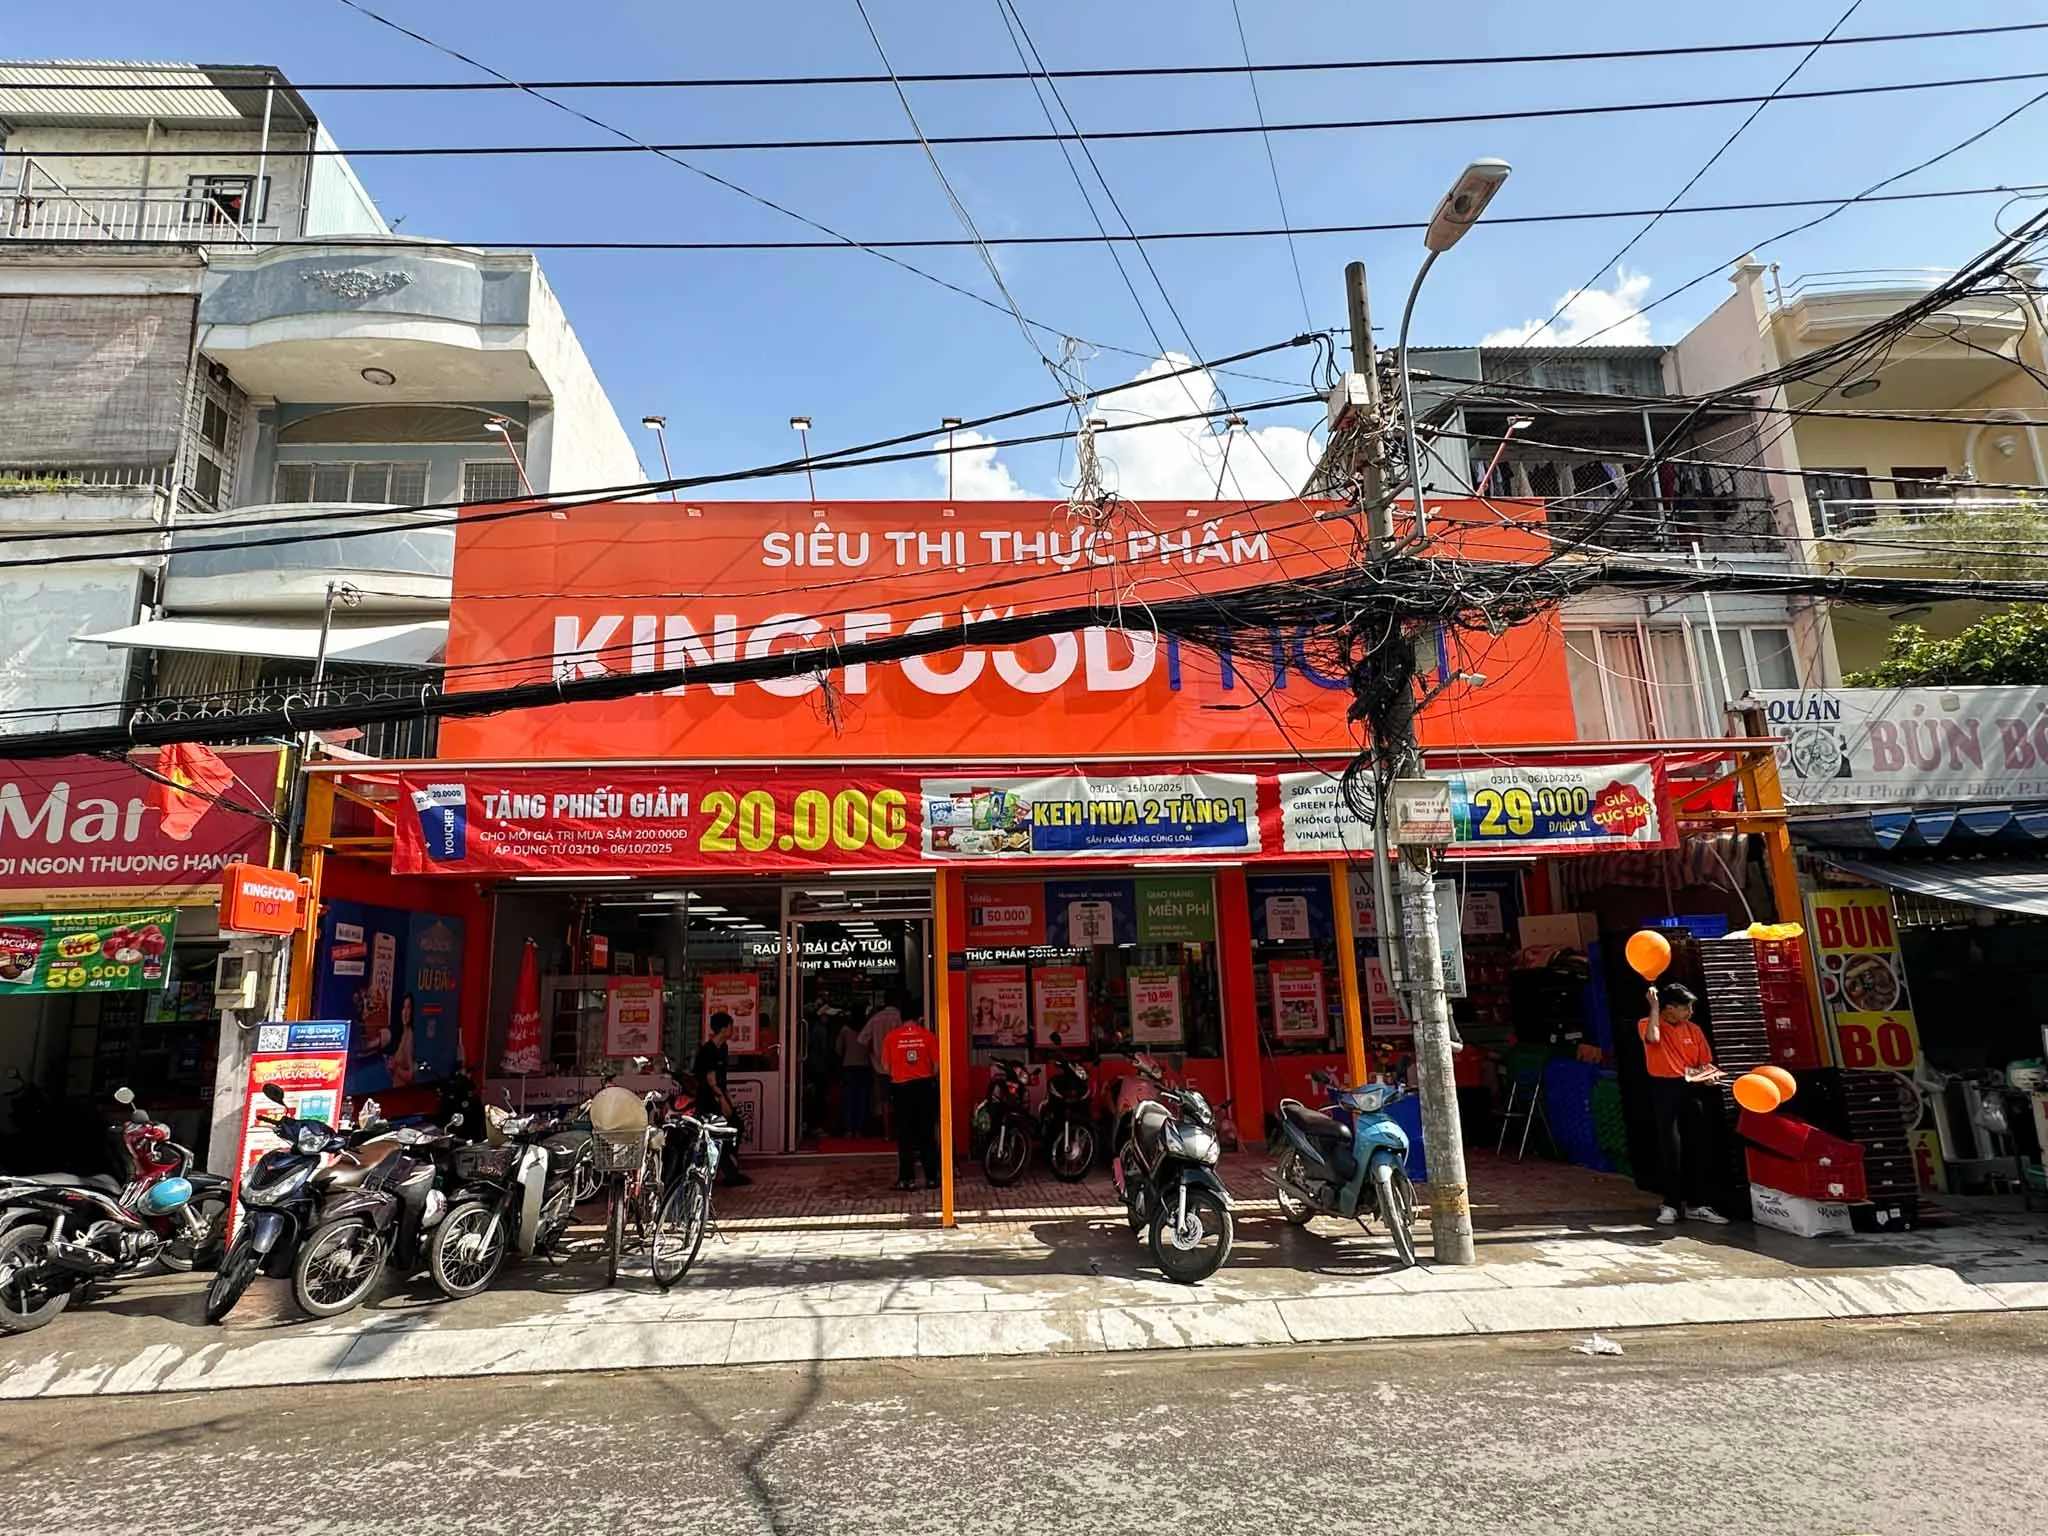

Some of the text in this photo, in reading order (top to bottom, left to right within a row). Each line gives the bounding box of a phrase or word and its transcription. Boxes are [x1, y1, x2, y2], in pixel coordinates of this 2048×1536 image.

[762, 522, 869, 567] SIÊU
[884, 531, 966, 573] THỊ
[979, 525, 1116, 573] THỰC
[552, 603, 1156, 697] KINGFOOD
[1768, 695, 1840, 721] QUÁN
[1090, 785, 1117, 794] 03/10
[1127, 783, 1182, 793] 15/10/2025
[1491, 776, 1518, 785] 03/10
[1528, 775, 1583, 784] 06/10/2025
[2018, 782, 2048, 796] P.1
[1292, 786, 1311, 796] SỮA
[1604, 792, 1631, 807] GIÁ
[0, 782, 192, 844] Mar
[482, 785, 689, 827] TẶNG PHIẾU GIẢM
[1033, 794, 1246, 830] KEM MUA 2 TẶNG 1
[1293, 801, 1352, 810] GREEN FAR
[1474, 786, 1589, 836] 29.000
[1295, 814, 1370, 824] KHÔNG ĐƯỜ
[444, 809, 455, 854] VOUCHER
[480, 831, 505, 840] CHO
[533, 828, 554, 840] GIÁ
[557, 831, 574, 842] TRỊ
[577, 830, 603, 840] MUA
[1296, 831, 1344, 839] VINAMILK
[494, 843, 510, 855] ÁP
[513, 845, 547, 857] DỤNG
[569, 844, 600, 855] 03/10
[610, 843, 672, 854] 06/10/2025
[20, 855, 84, 873] NGON
[89, 854, 179, 876] THƯỢNG
[243, 882, 295, 902] KINGFOOD
[1148, 901, 1183, 916] MIỄN
[1815, 899, 1894, 948] BÚN
[753, 943, 780, 955] RAU
[802, 939, 828, 952] RÁI
[831, 938, 856, 952] CÂY
[860, 938, 892, 952] TƯƠI
[1840, 1016, 1914, 1068] BÒ
